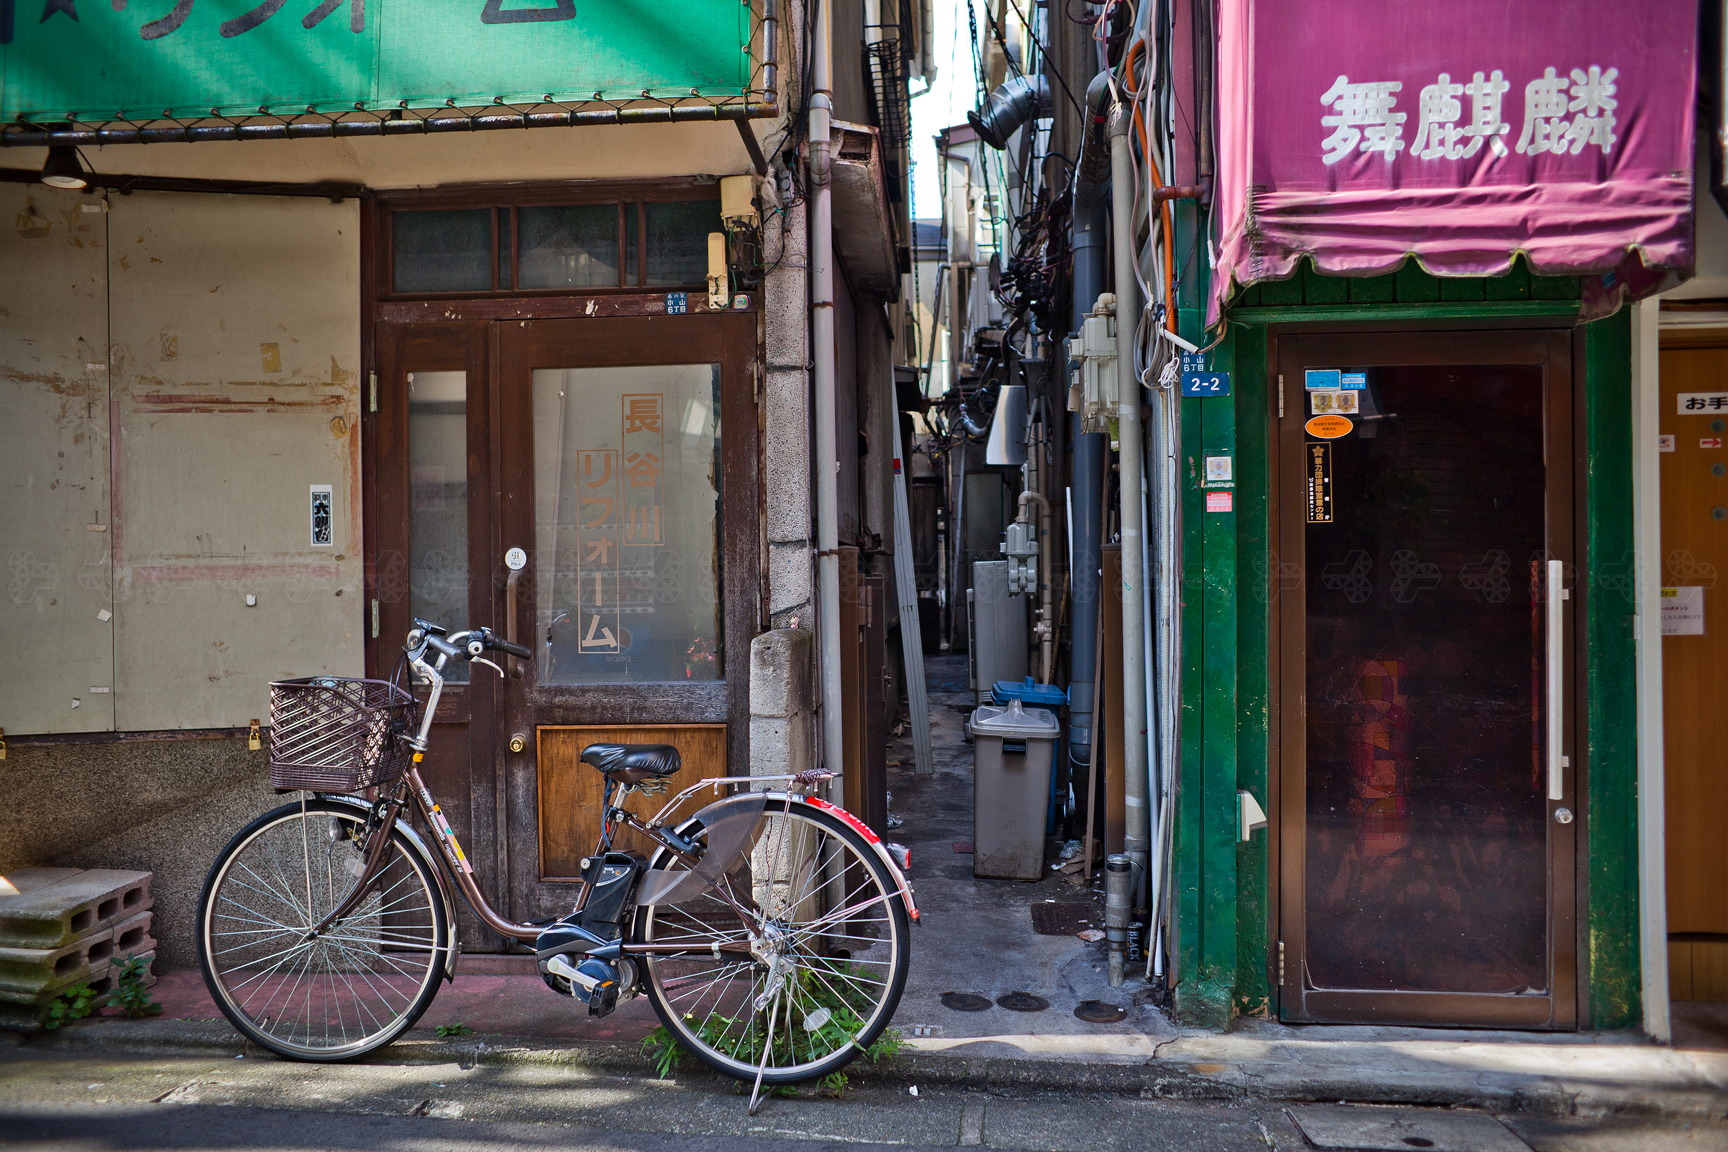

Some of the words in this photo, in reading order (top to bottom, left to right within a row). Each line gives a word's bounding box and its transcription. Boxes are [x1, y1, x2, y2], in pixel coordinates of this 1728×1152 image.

[1320, 65, 1618, 164] 舞麒麟
[667, 306, 686, 314] 6丁目
[1183, 356, 1204, 364] 小山
[1183, 364, 1204, 372] 6丁目
[1191, 377, 1220, 391] 2-2
[1685, 396, 1728, 410] お手
[625, 399, 661, 542] 長谷川
[581, 453, 618, 649] リフォーム
[428, 811, 447, 841] Panasonic
